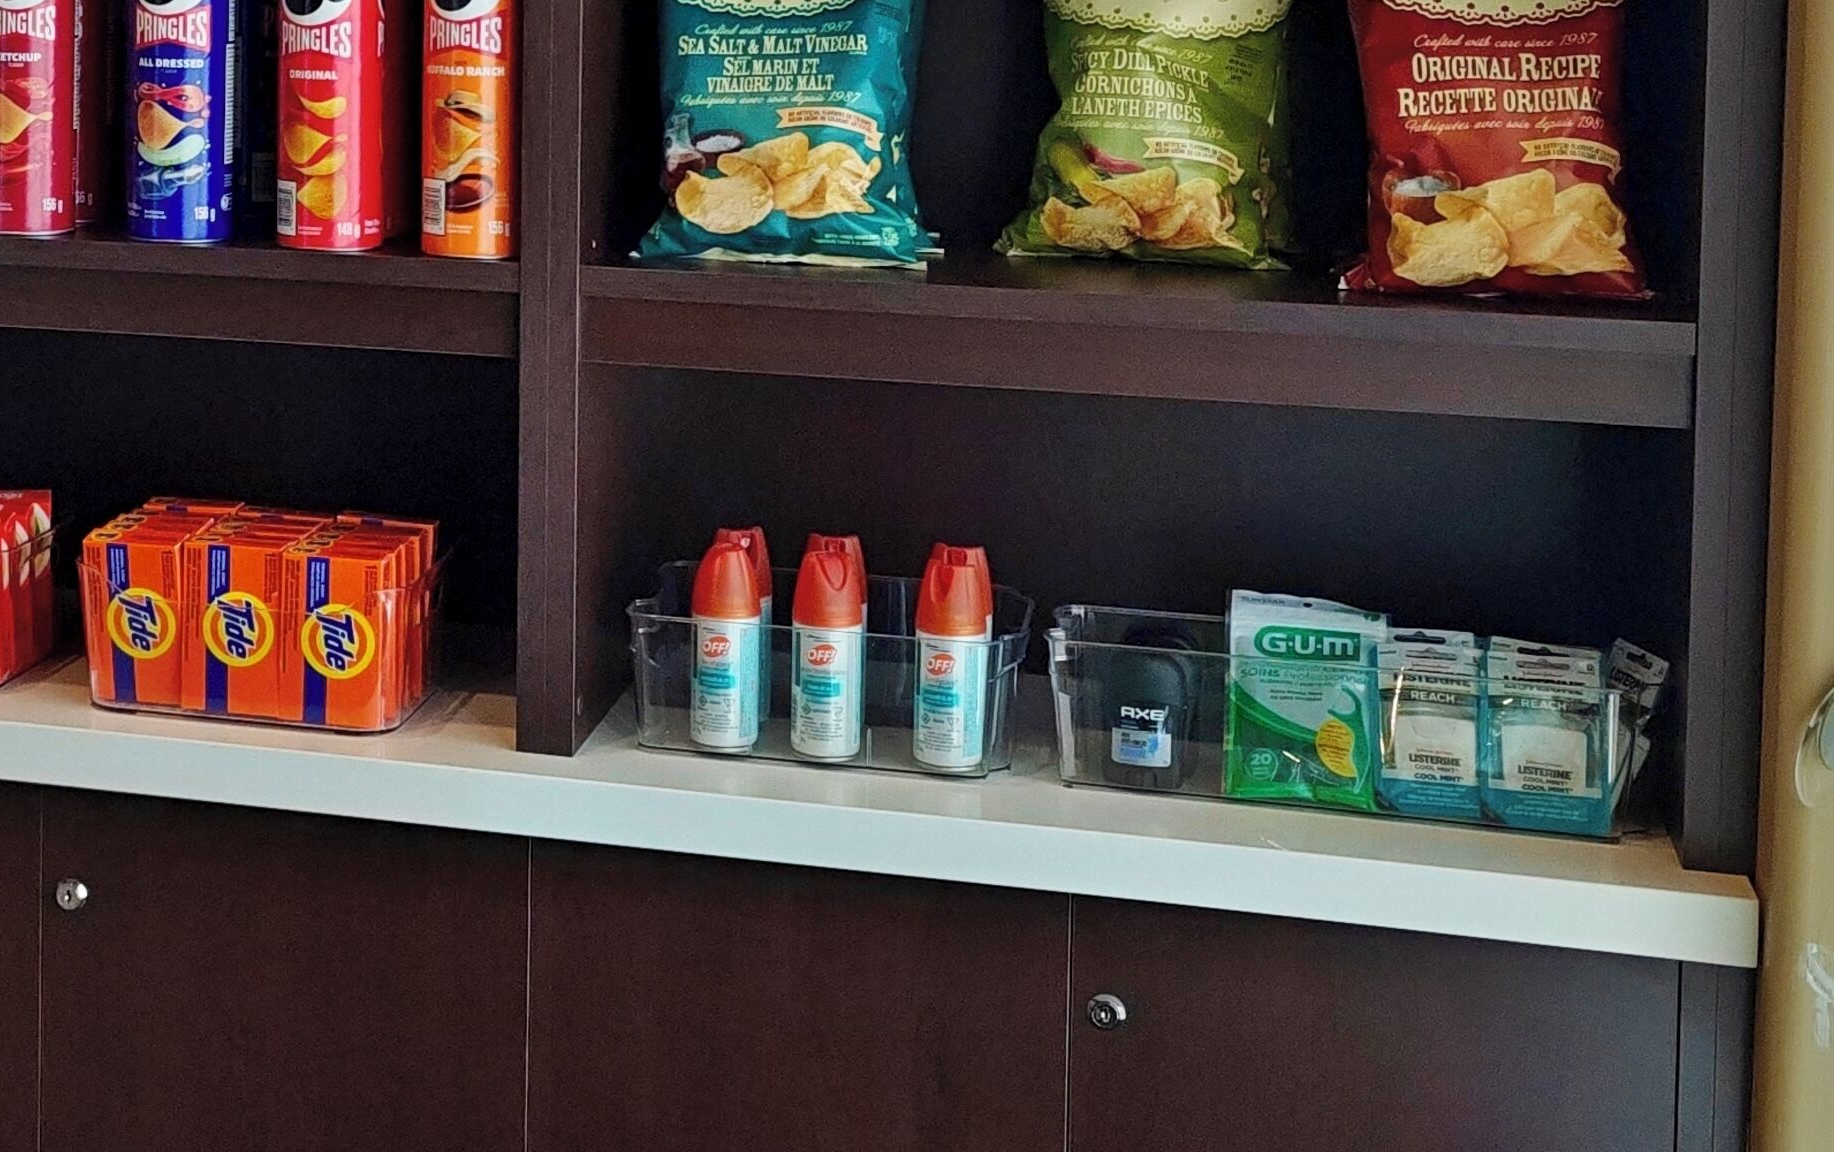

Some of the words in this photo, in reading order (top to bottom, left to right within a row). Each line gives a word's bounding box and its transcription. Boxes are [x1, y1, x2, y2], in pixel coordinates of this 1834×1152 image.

[137, 8, 207, 47] PRINGLES
[820, 20, 853, 33] 1987
[282, 21, 352, 58] PRINGLES
[430, 16, 501, 54] PRINGLES
[1414, 34, 1463, 50] Crafted
[1464, 35, 1491, 47] with
[1494, 39, 1522, 48] care
[1524, 38, 1554, 47] since
[1559, 32, 1598, 46] 1987
[747, 41, 760, 54] &
[139, 58, 153, 67] ALL
[155, 59, 204, 68] DRESSED
[1178, 48, 1214, 64] 1987
[466, 66, 505, 76] RANCH
[752, 58, 799, 75] MARIN
[801, 58, 819, 74] ET
[1114, 48, 1155, 73] DILL
[1155, 51, 1210, 89] PICKLE
[1412, 52, 1516, 83] ORIGINAL
[1519, 52, 1602, 81] RECIPE
[290, 70, 338, 80] ORIGINAL
[707, 76, 772, 94] VINAIGRE
[774, 75, 794, 92] DE
[796, 74, 834, 91] MALT
[1075, 73, 1185, 101] CORNICHONS
[827, 91, 861, 103] 1987
[1397, 87, 1497, 117] RECETTE
[1071, 97, 1140, 117] L'ANETH
[1194, 125, 1224, 139] 1987
[42, 198, 56, 211] 156
[488, 221, 504, 234] 156
[118, 594, 159, 652] Tide
[216, 597, 256, 661] Tide
[315, 610, 355, 672] Tide
[702, 640, 730, 654] OFF!
[807, 647, 837, 664] OFF!
[926, 656, 955, 674] OFF!
[1411, 690, 1455, 703] REACH
[1521, 699, 1566, 710] REACH
[1121, 706, 1165, 721] AXE
[1250, 753, 1272, 765] 20
[1408, 753, 1462, 766] LISTERINE
[1518, 765, 1573, 780] LISTERINE
[1523, 776, 1544, 784] COOL
